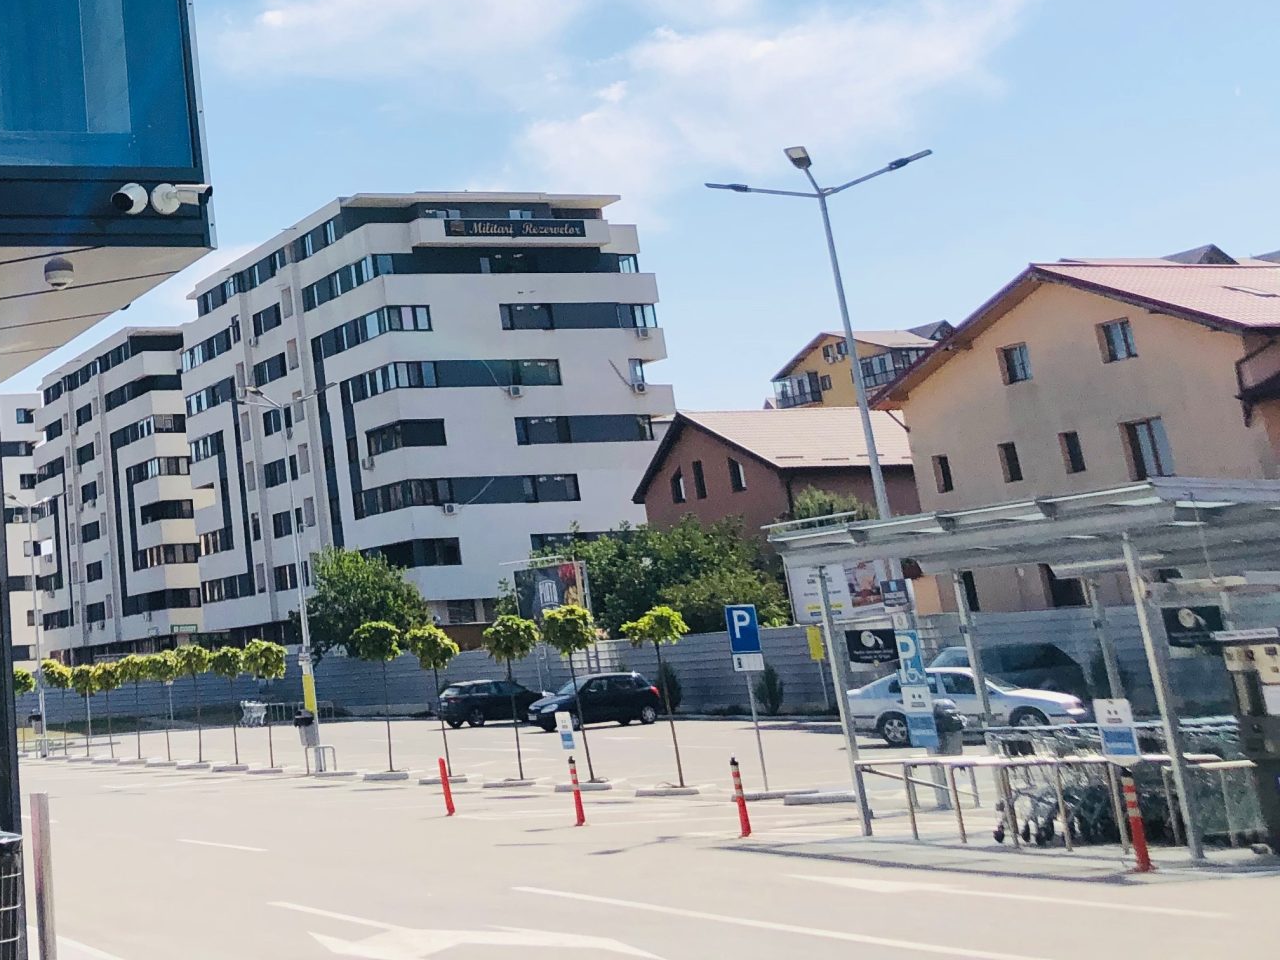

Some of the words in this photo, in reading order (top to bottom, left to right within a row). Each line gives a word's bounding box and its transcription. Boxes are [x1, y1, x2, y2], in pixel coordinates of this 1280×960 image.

[470, 222, 514, 235] Militari
[522, 222, 581, 235] Rezervelor
[732, 610, 751, 639] P
